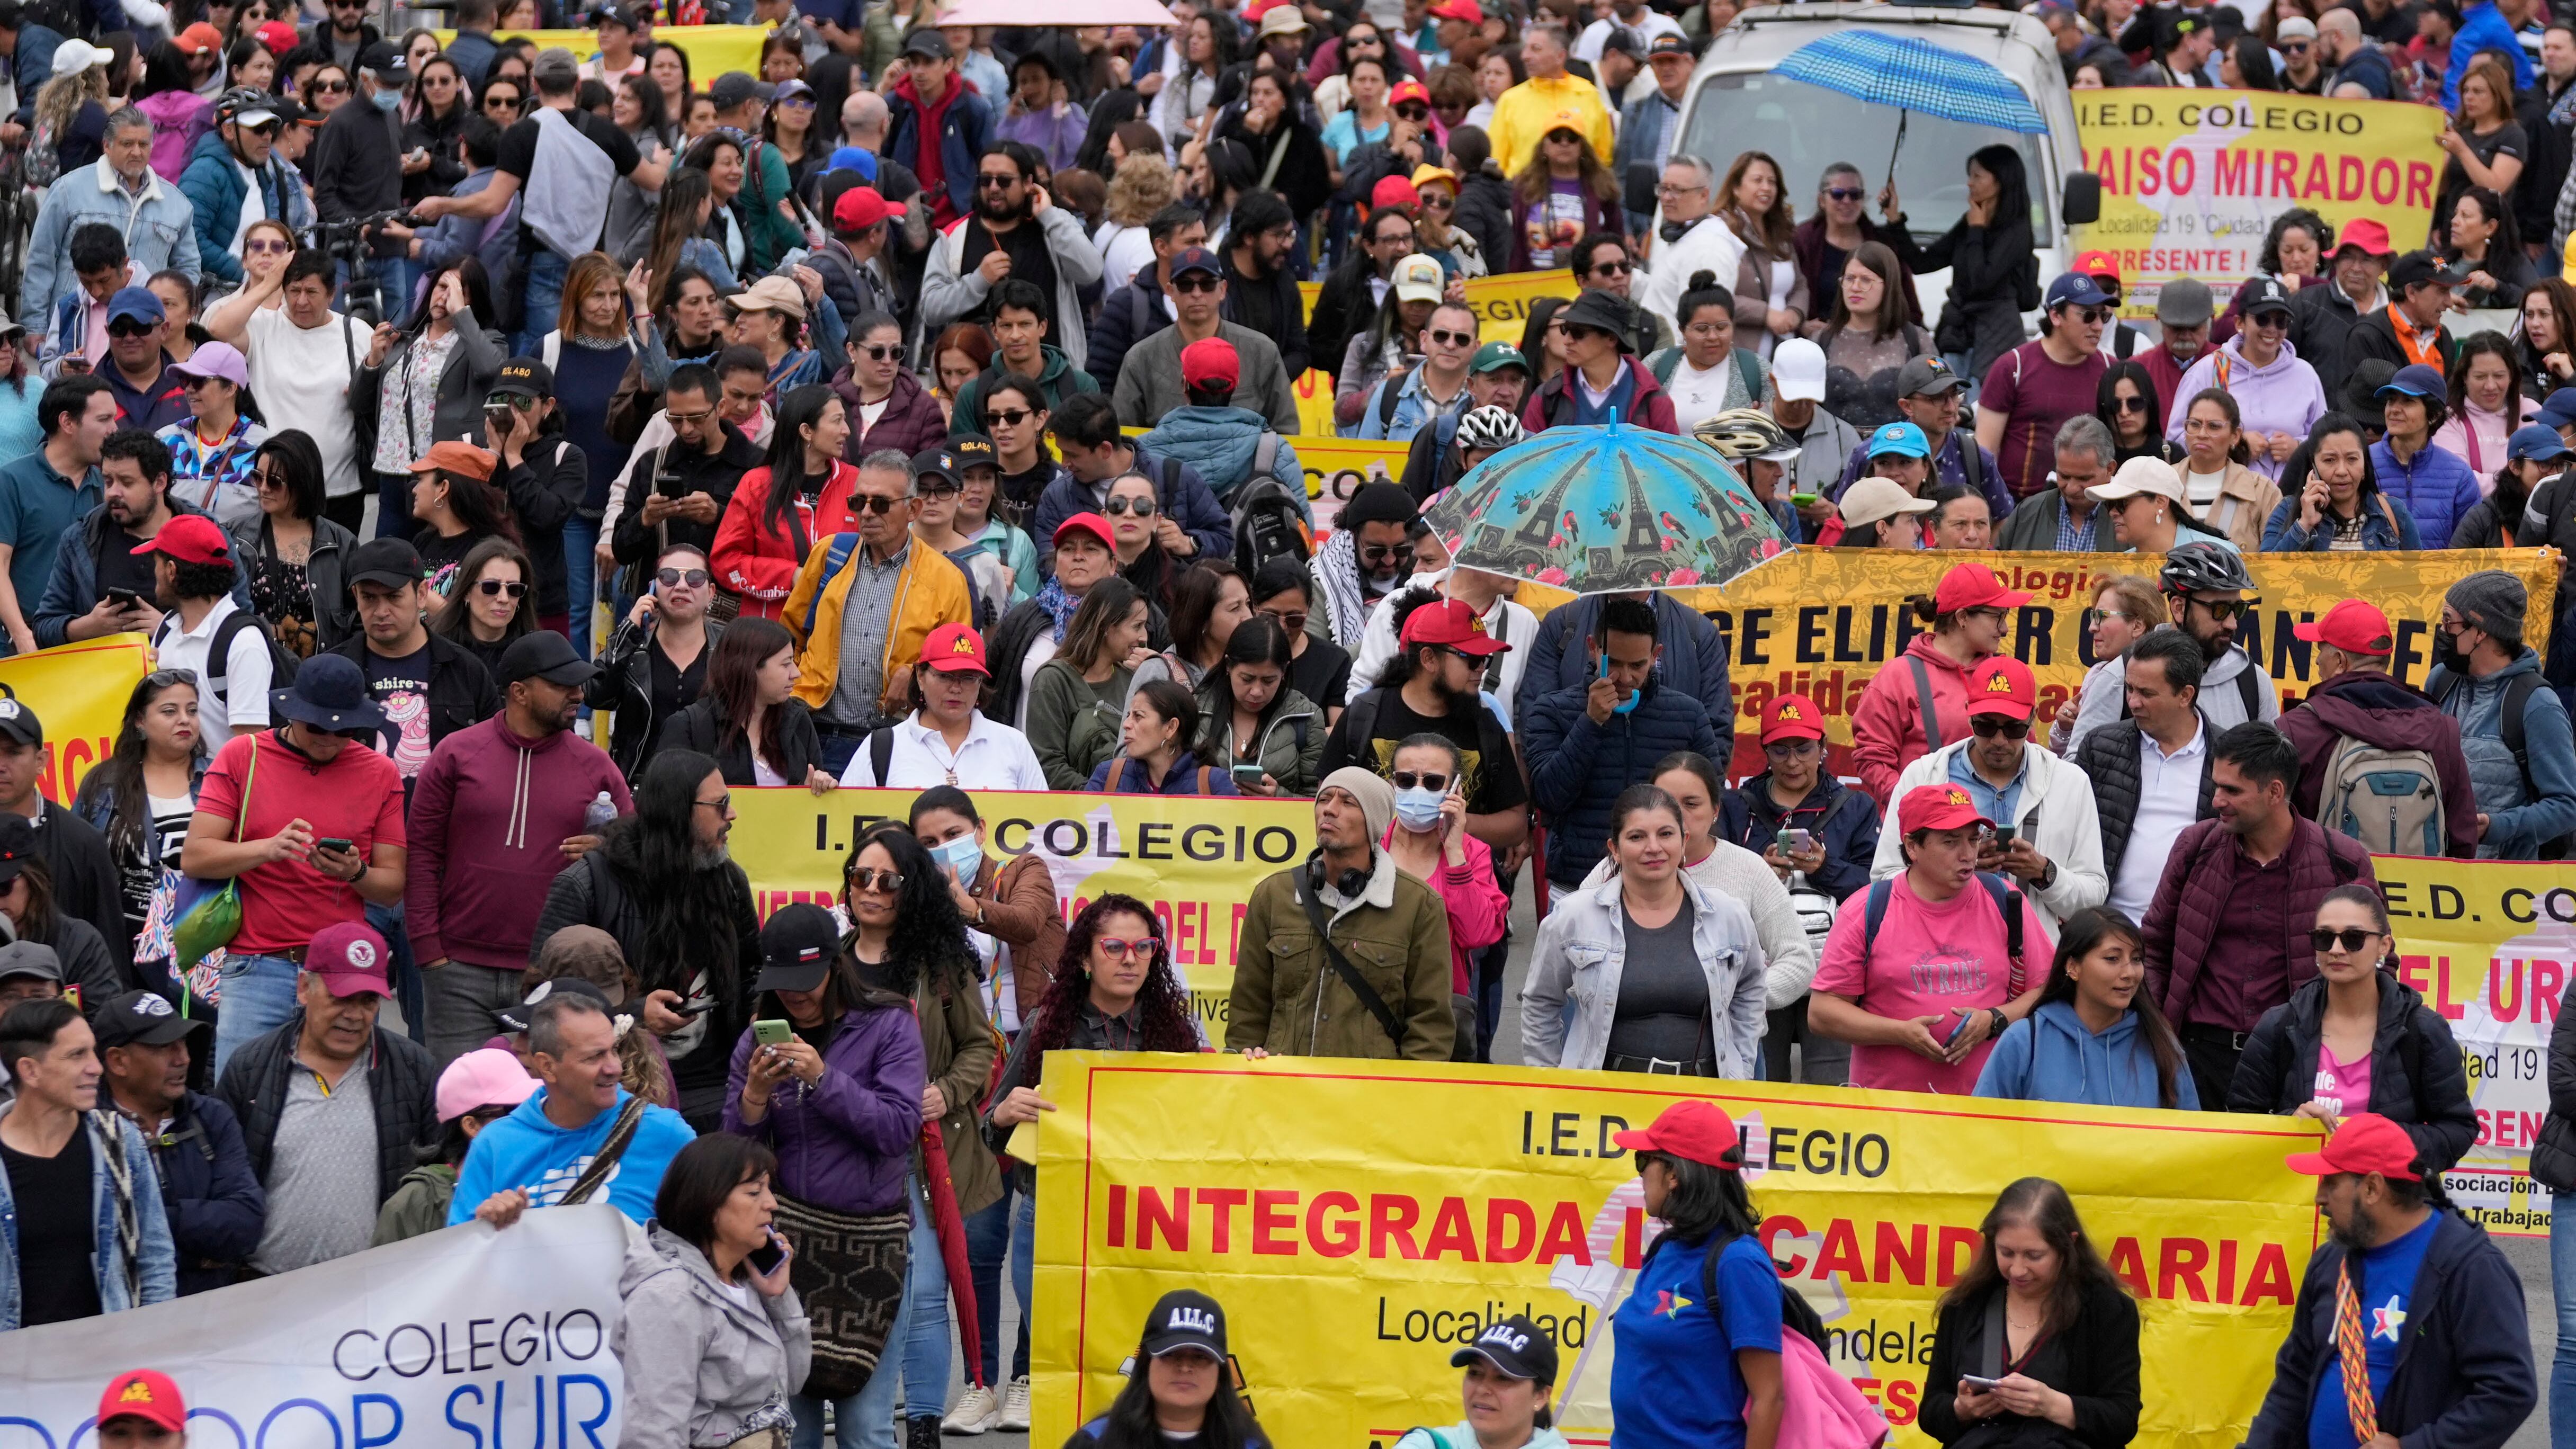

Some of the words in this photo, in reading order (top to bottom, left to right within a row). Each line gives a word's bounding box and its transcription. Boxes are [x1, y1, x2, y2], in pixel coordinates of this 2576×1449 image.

[2081, 105, 2163, 127] I.E.D.
[2178, 105, 2364, 136] COLEGIO
[2083, 147, 2194, 196] AISO
[2214, 148, 2433, 209] MIRADOR
[2098, 214, 2169, 235] Localidad
[2177, 214, 2196, 234] 19
[739, 577, 791, 599] Columbia
[373, 676, 414, 690] shire
[1986, 676, 2012, 694] ADE
[1777, 705, 1802, 721] ADE
[1949, 790, 1971, 805] ADE
[995, 818, 1298, 864] COLEGIO
[2510, 1048, 2538, 1080] 19
[2444, 1175, 2538, 1195] sociación
[1107, 1184, 1593, 1266] INTEGRADA
[1759, 1213, 2295, 1307] CANDARIA
[333, 1308, 603, 1381] COLEGIO
[445, 1374, 613, 1449] SUR
